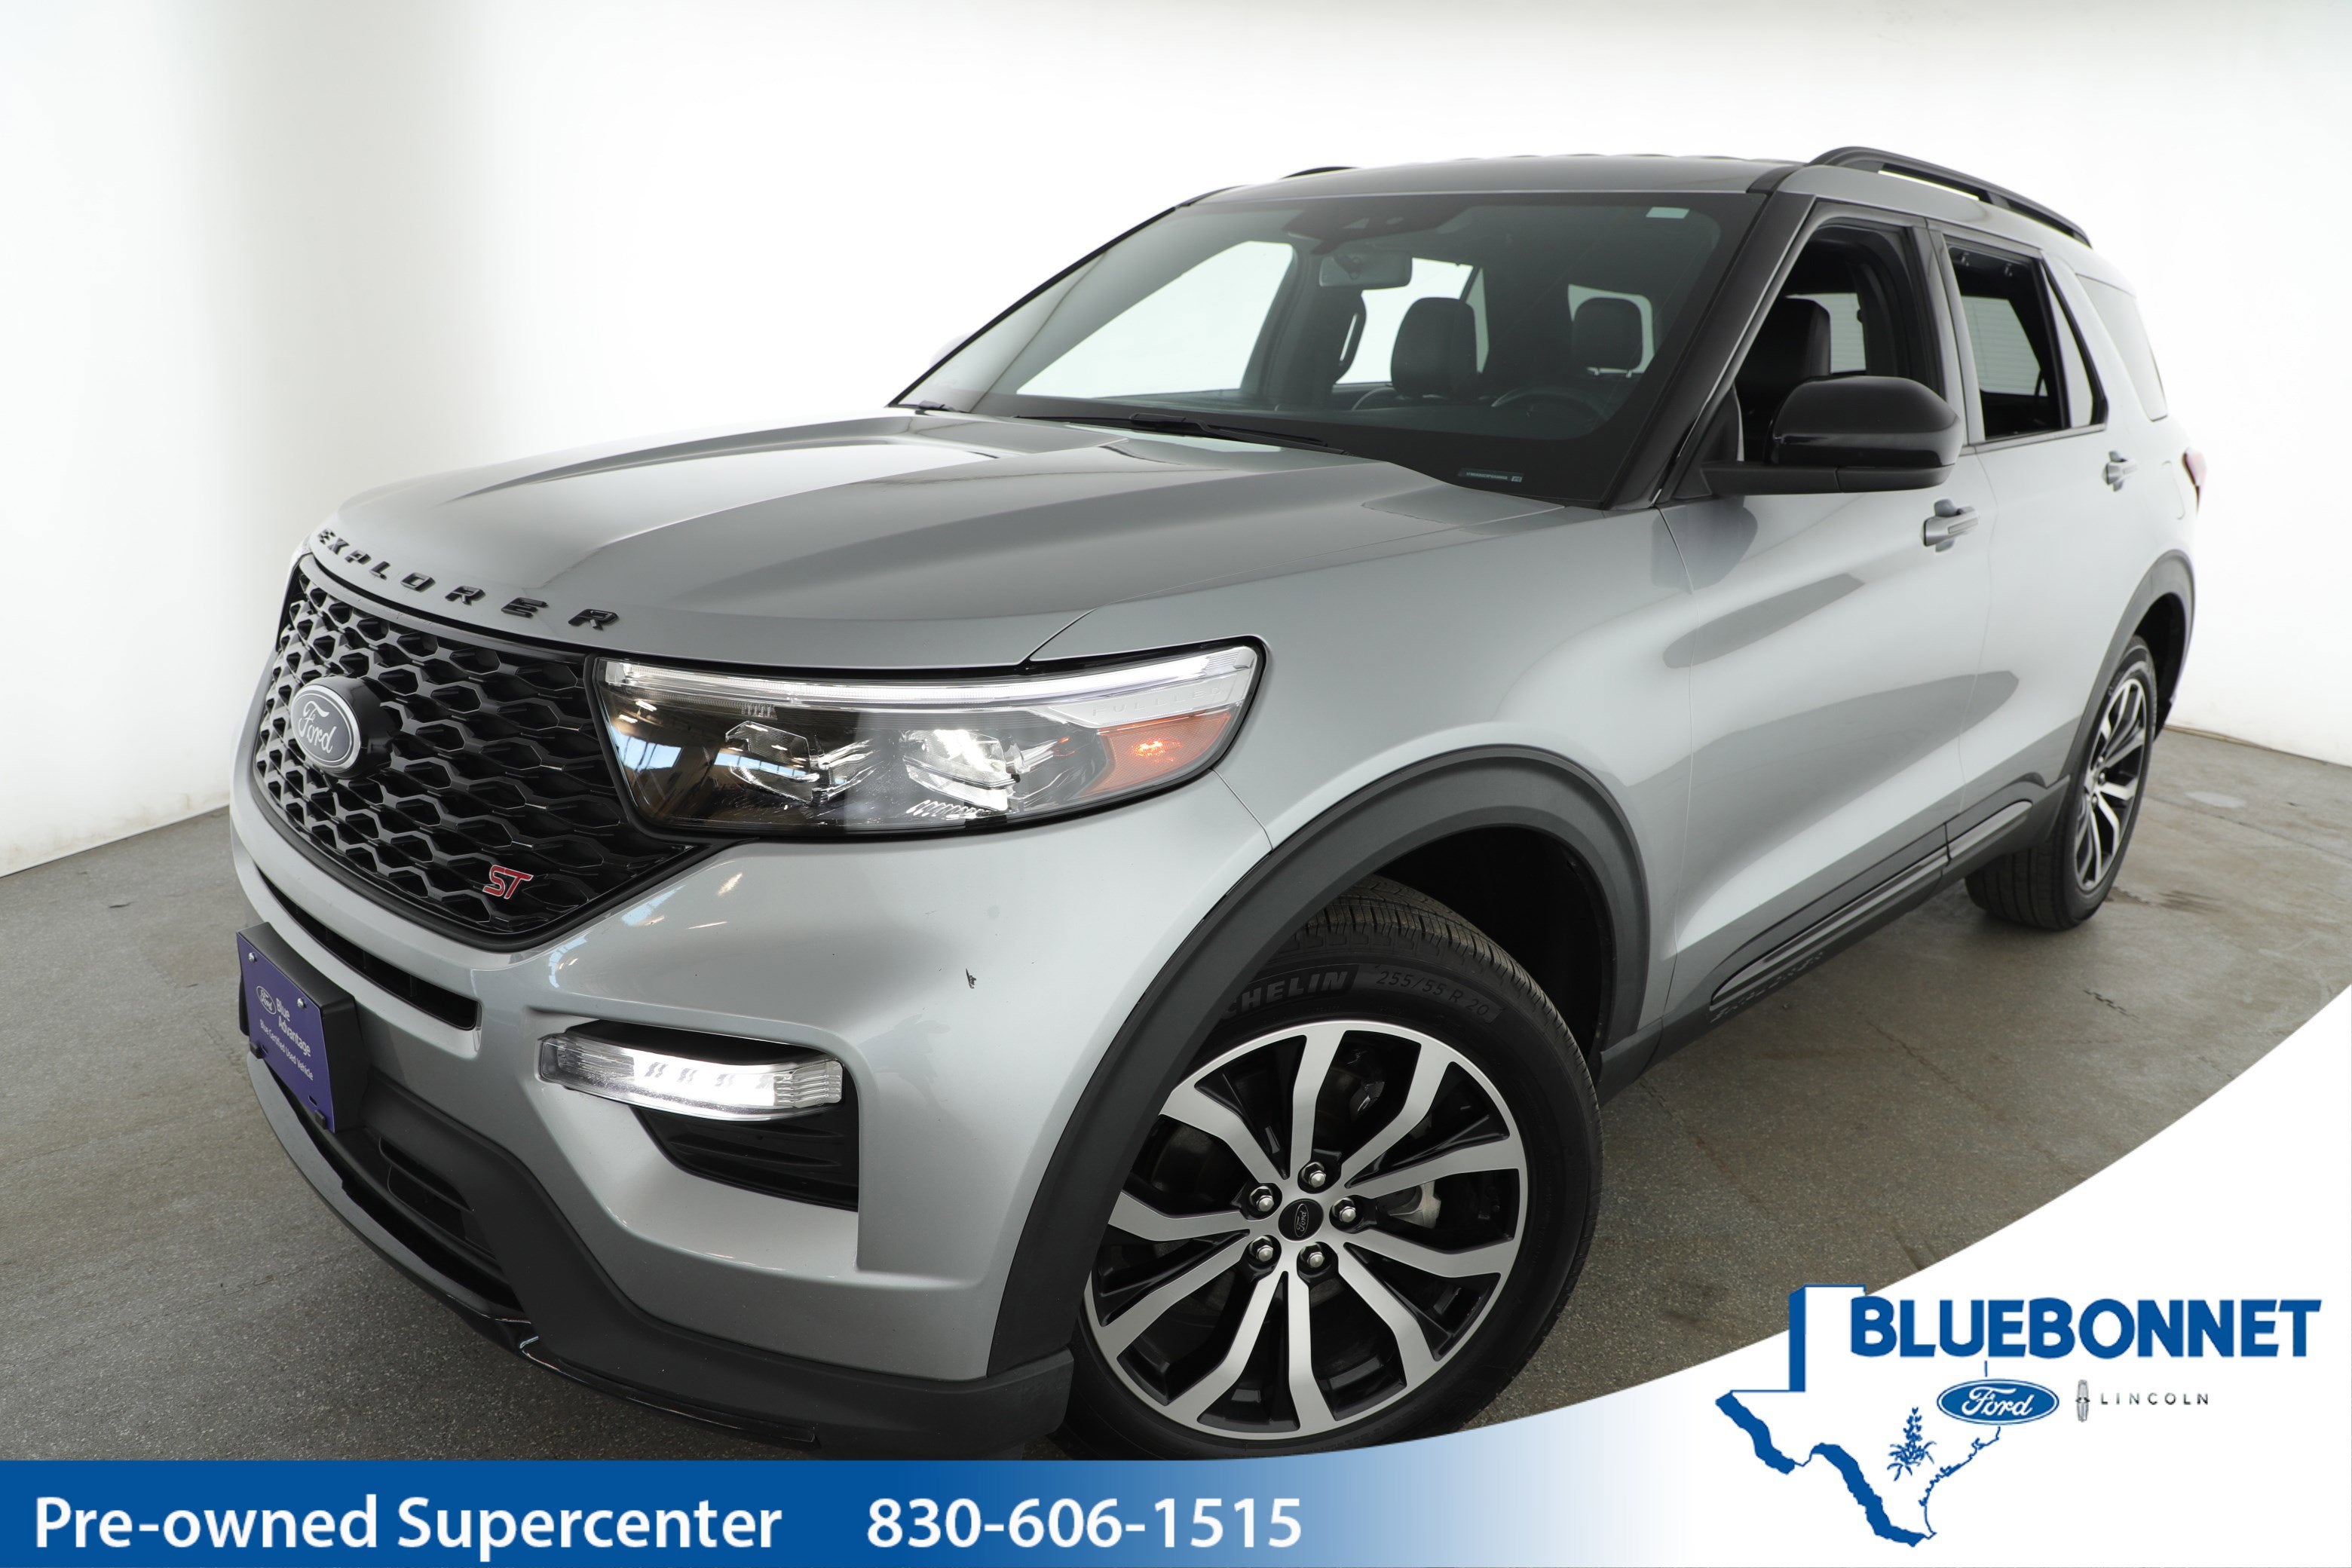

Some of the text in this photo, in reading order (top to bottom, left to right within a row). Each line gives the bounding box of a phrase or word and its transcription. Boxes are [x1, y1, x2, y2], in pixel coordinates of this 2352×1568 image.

[317, 528, 620, 630] EXPLORER
[298, 700, 337, 754] Ford
[482, 865, 534, 899] ST
[260, 989, 273, 1012] Ford
[276, 997, 290, 1022] Blue
[1224, 970, 1349, 1017] HELIN
[1375, 970, 1490, 1016] 255/55 R 20
[278, 1015, 311, 1058] Advantage
[296, 1058, 314, 1081] Vehicle
[1297, 1211, 1308, 1232] Ford
